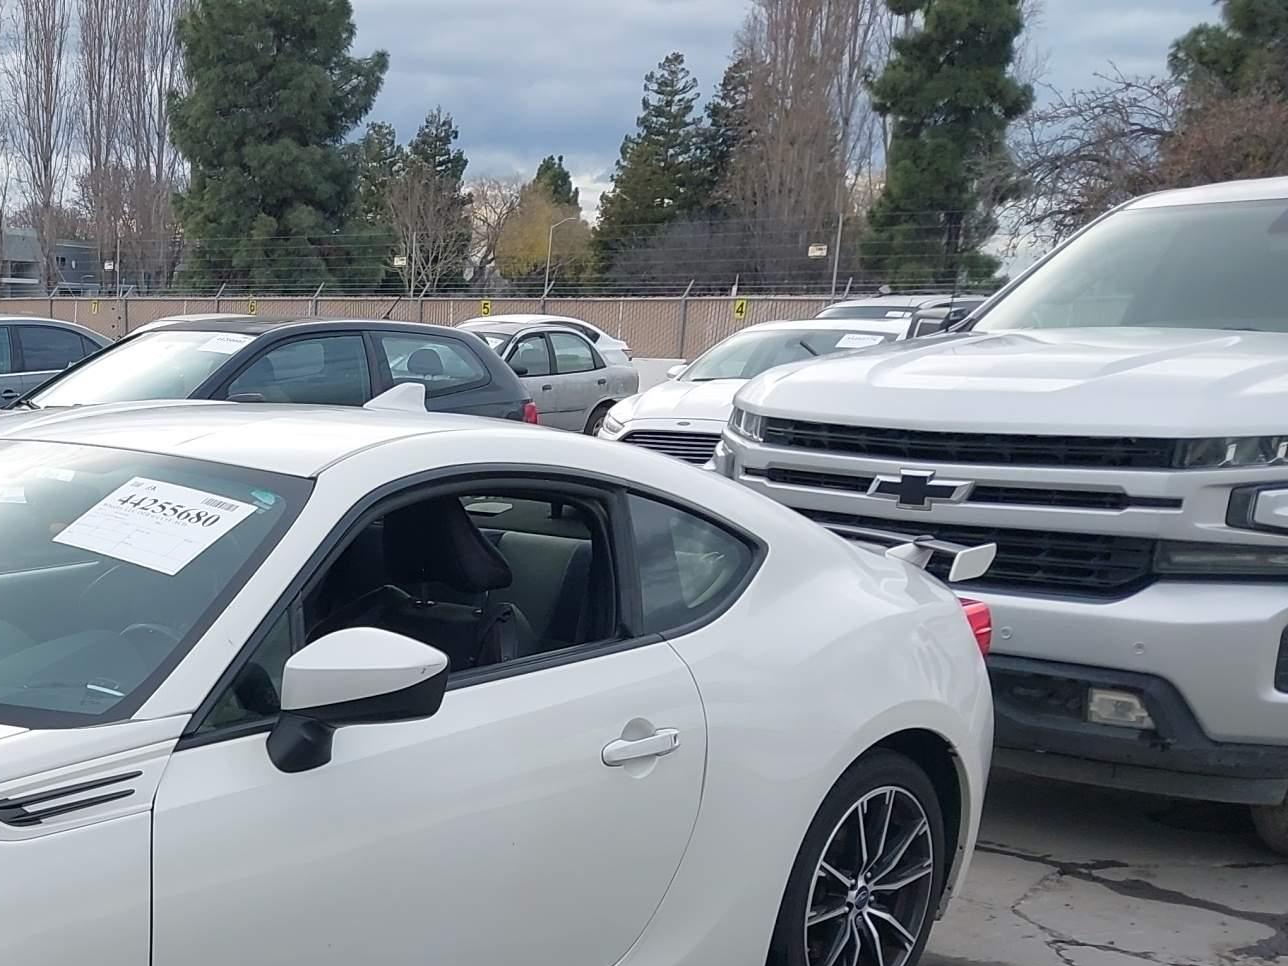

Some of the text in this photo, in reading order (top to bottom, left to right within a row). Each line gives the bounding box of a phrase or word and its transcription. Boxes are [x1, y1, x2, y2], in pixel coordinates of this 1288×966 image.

[482, 302, 490, 315] 5
[735, 302, 745, 317] 4
[117, 494, 221, 527] 44255680
